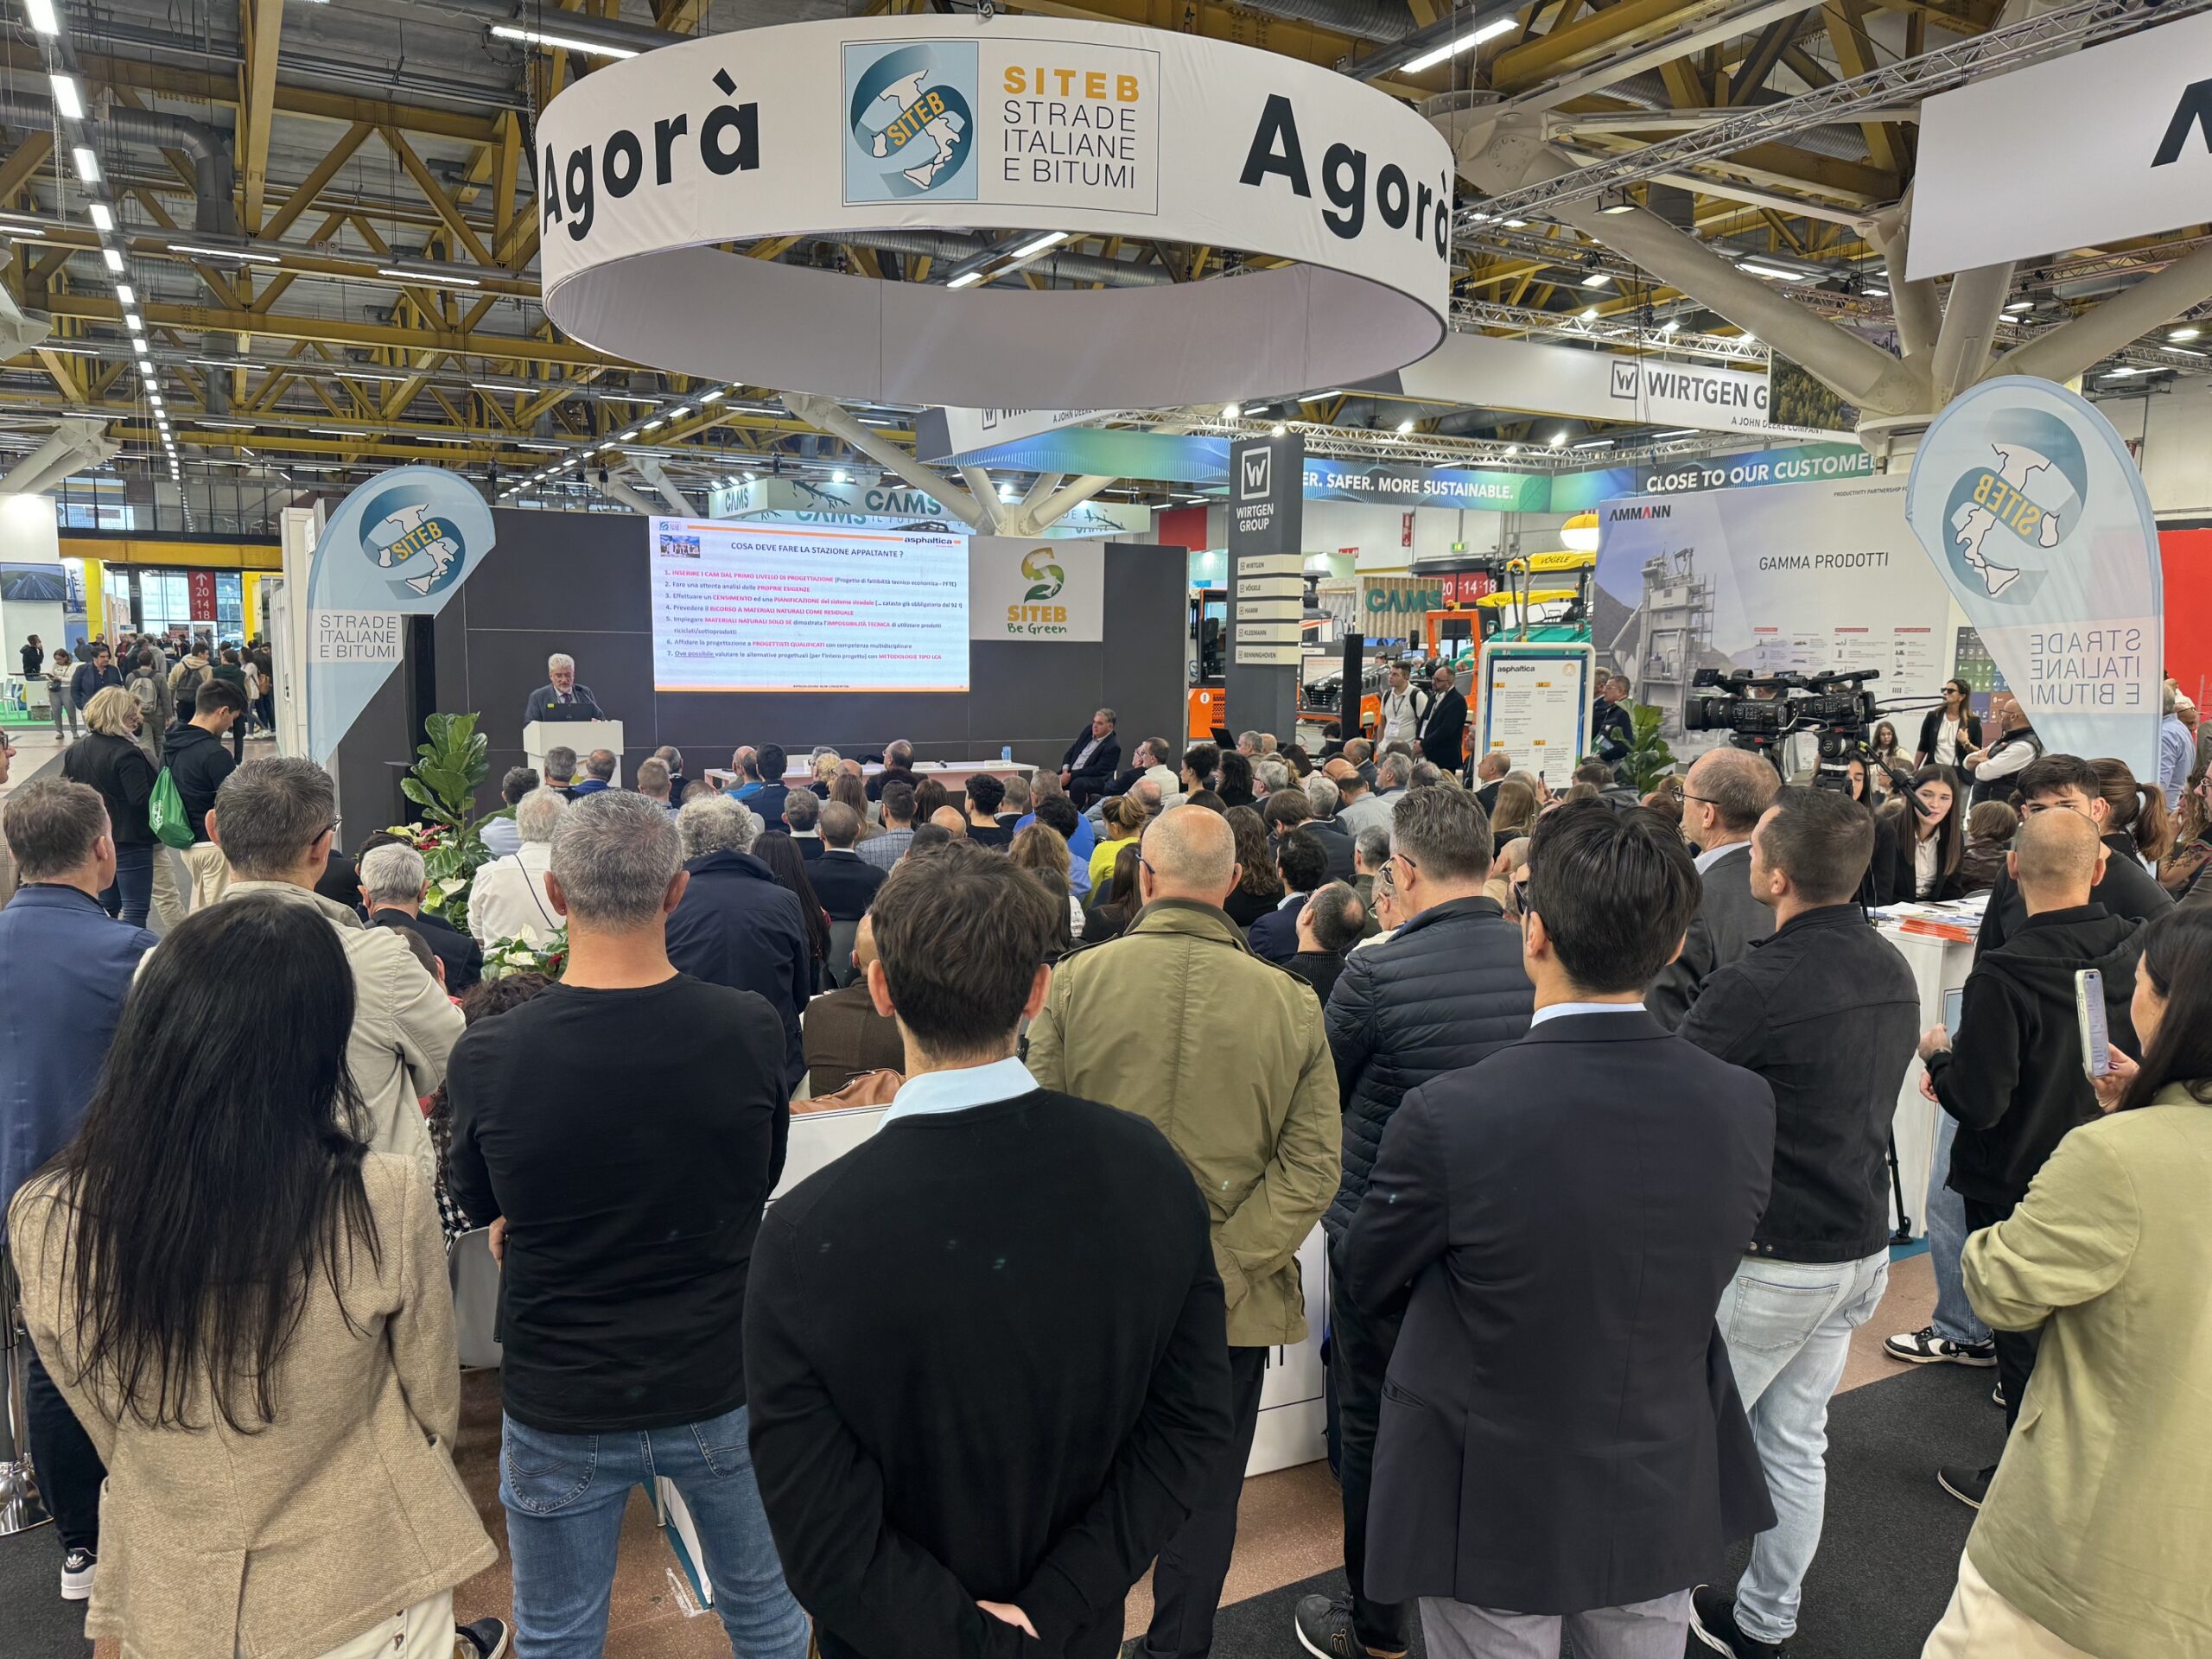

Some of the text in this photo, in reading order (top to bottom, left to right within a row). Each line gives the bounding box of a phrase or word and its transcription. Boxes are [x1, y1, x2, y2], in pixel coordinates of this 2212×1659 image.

[1003, 66, 1140, 103] SITEB
[887, 91, 946, 147] SITEB
[1003, 100, 1136, 133] STRADE
[1004, 130, 1135, 161] ITALIANE
[543, 67, 760, 242] Agorà
[1004, 158, 1135, 189] E BITUMI
[1238, 92, 1449, 264] Agorà
[1648, 371, 1749, 408] WIRTGEN
[1053, 410, 1073, 423] A JOHN
[1732, 416, 1761, 428] A JOHN
[1326, 474, 1374, 491] SAFER.
[1378, 477, 1420, 493] MORE
[1423, 480, 1514, 499] SUSTAINABLE.
[1646, 472, 1698, 493] CLOSE
[1701, 468, 1726, 488] TO
[1730, 464, 1770, 484] OUR
[725, 488, 749, 512] CAMS
[865, 490, 942, 515] CAMS
[1236, 503, 1274, 519] WIRTGEN
[1608, 505, 1672, 523] AMMANN
[1239, 518, 1269, 532] GROUP
[391, 522, 442, 561] SITEB
[904, 537, 953, 545] asphaltica
[851, 549, 898, 557] APPALTANTE
[1541, 556, 1570, 564] VÖGELE
[1759, 551, 1890, 570] GAMMA PRODOTTI
[195, 588, 209, 596] 20
[1464, 579, 1497, 595] 14 18
[196, 600, 209, 609] 14
[1365, 588, 1444, 613] CAMS
[197, 610, 210, 620] 18
[320, 614, 397, 629] STRADE
[1007, 605, 1067, 622] SITEB
[320, 630, 396, 644] ITALIANE
[1007, 623, 1067, 634] Be Green
[320, 645, 396, 658] E BITUMI
[1497, 665, 1535, 674] asphaltica
